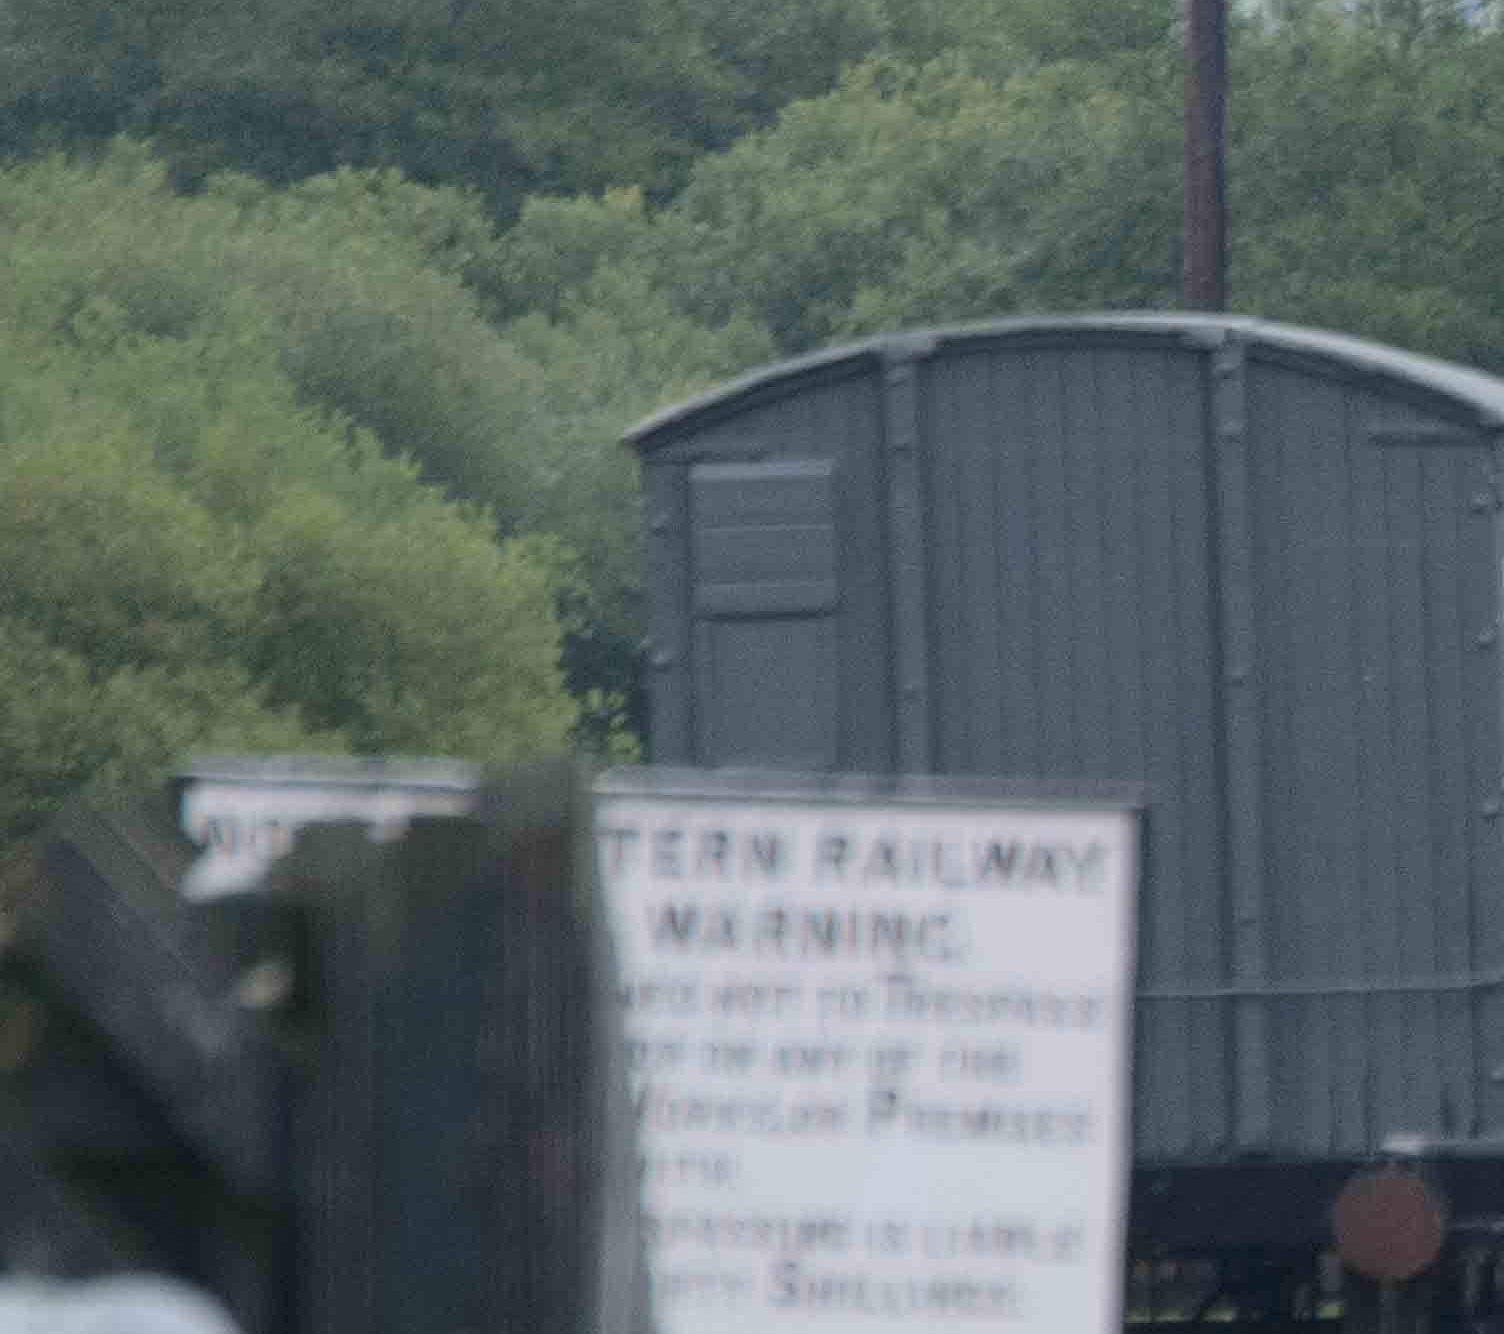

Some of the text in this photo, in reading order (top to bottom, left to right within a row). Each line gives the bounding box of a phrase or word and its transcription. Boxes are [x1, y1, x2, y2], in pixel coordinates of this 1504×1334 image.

[816, 835, 1113, 890] RAILWAY
[648, 903, 963, 959] WARNING
[873, 973, 1103, 1028] TRESPASS
